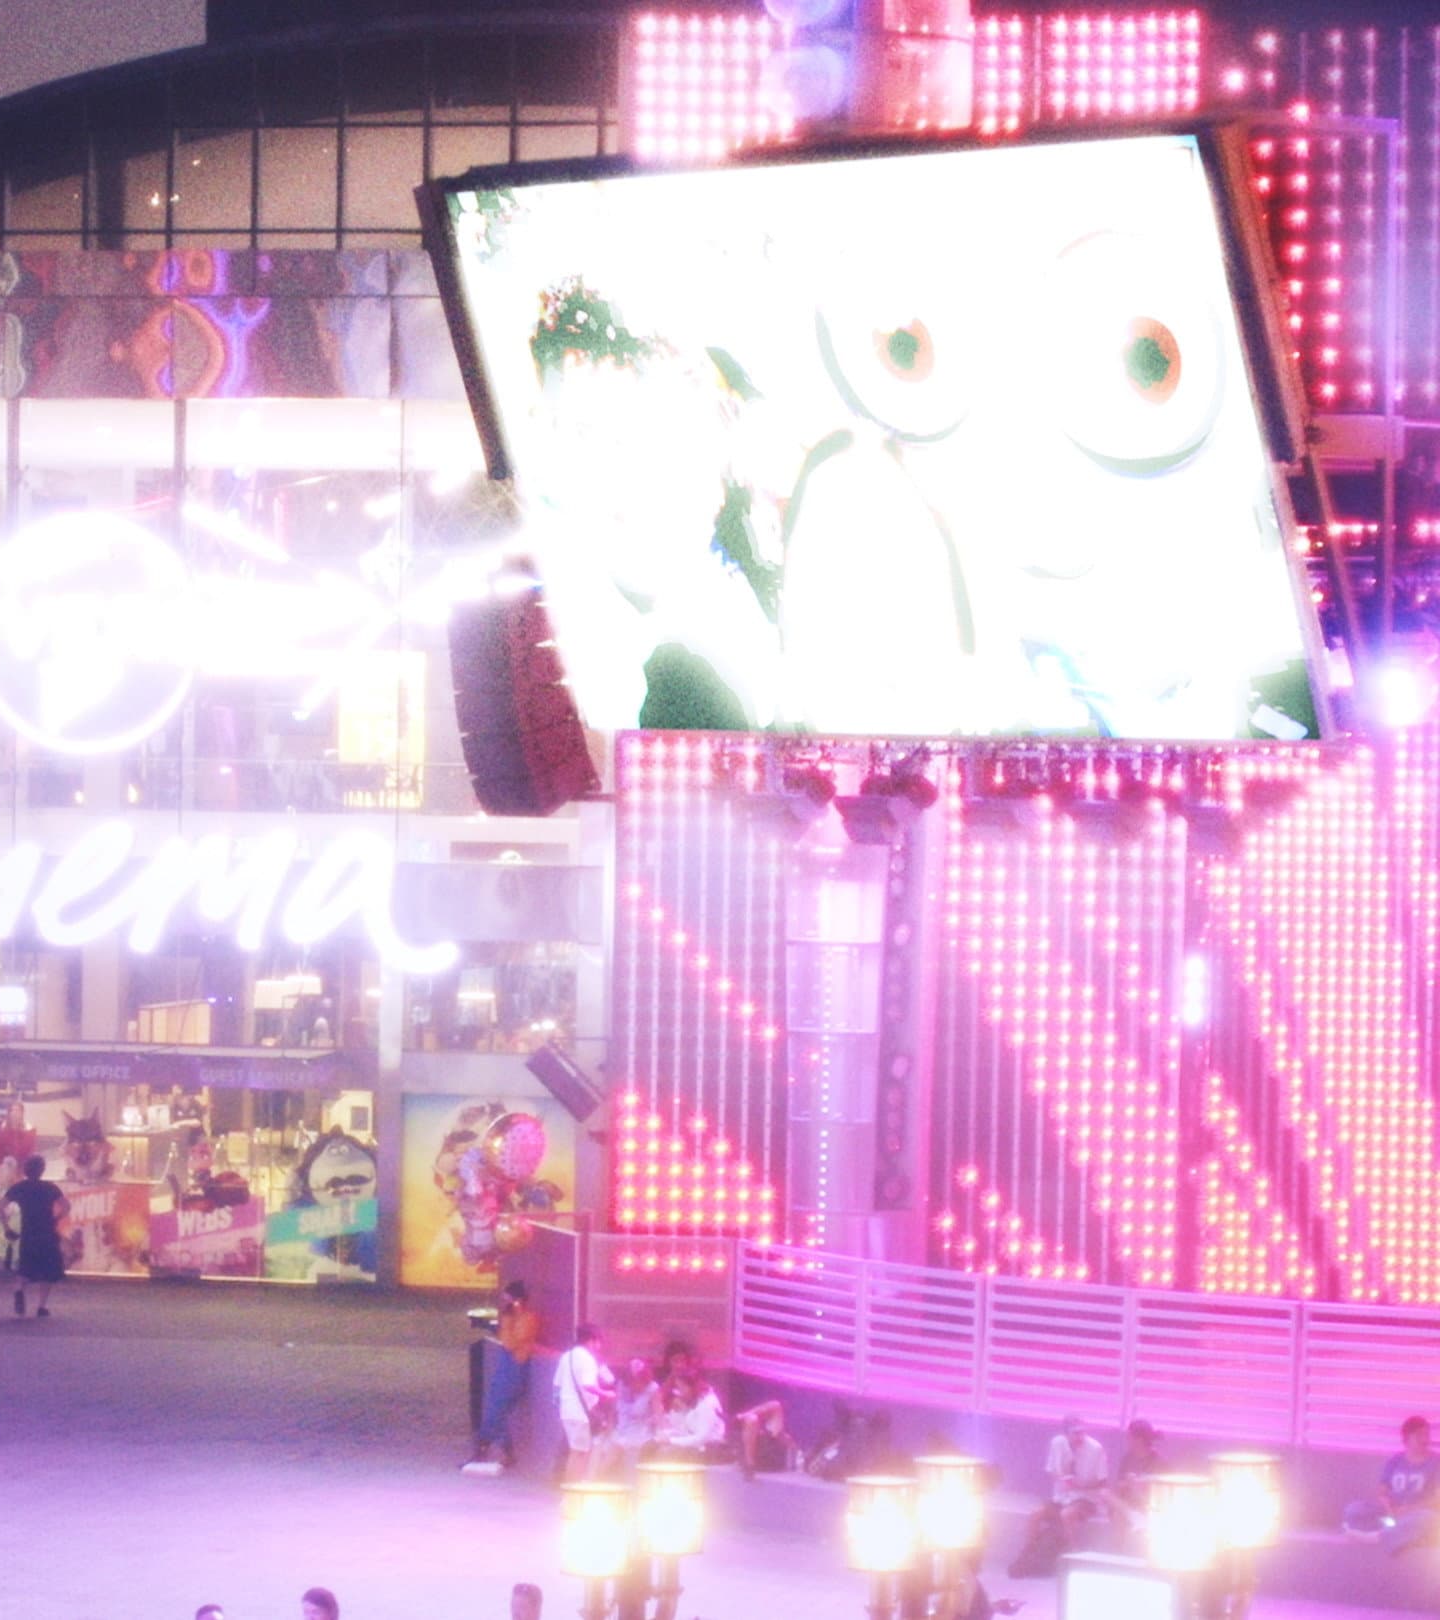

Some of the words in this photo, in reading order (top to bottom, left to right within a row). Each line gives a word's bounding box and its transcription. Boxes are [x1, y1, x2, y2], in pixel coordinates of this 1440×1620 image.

[48, 1064, 79, 1078] BOX
[82, 1065, 131, 1080] OFFICE
[199, 1068, 244, 1083] GUEST
[177, 1205, 233, 1238] WEBS
